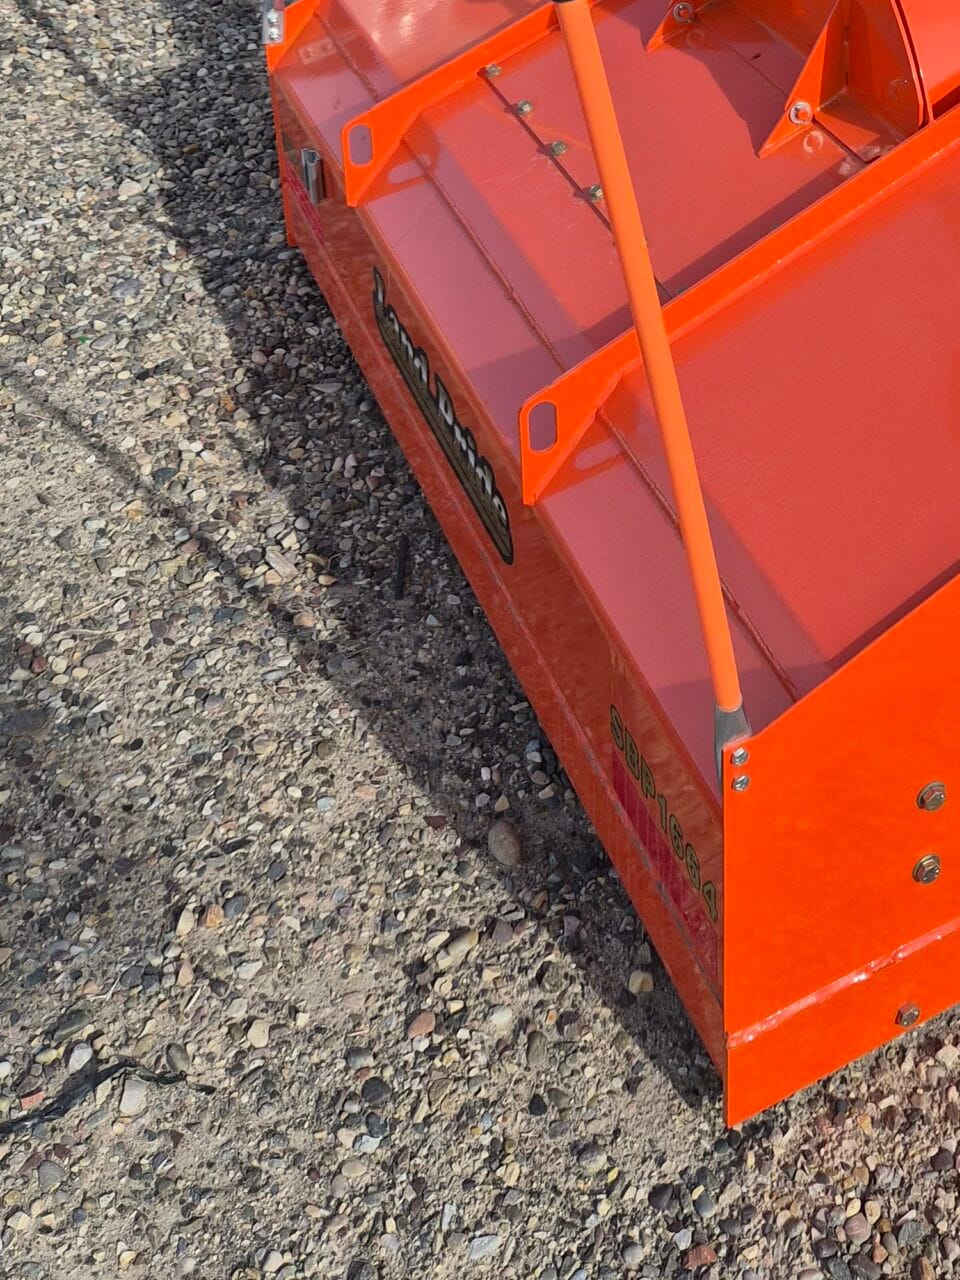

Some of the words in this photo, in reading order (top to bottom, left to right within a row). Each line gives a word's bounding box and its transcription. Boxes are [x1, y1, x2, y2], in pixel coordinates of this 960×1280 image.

[373, 267, 431, 392] Land
[434, 372, 511, 535] Pride
[610, 704, 718, 924] SBP1664
